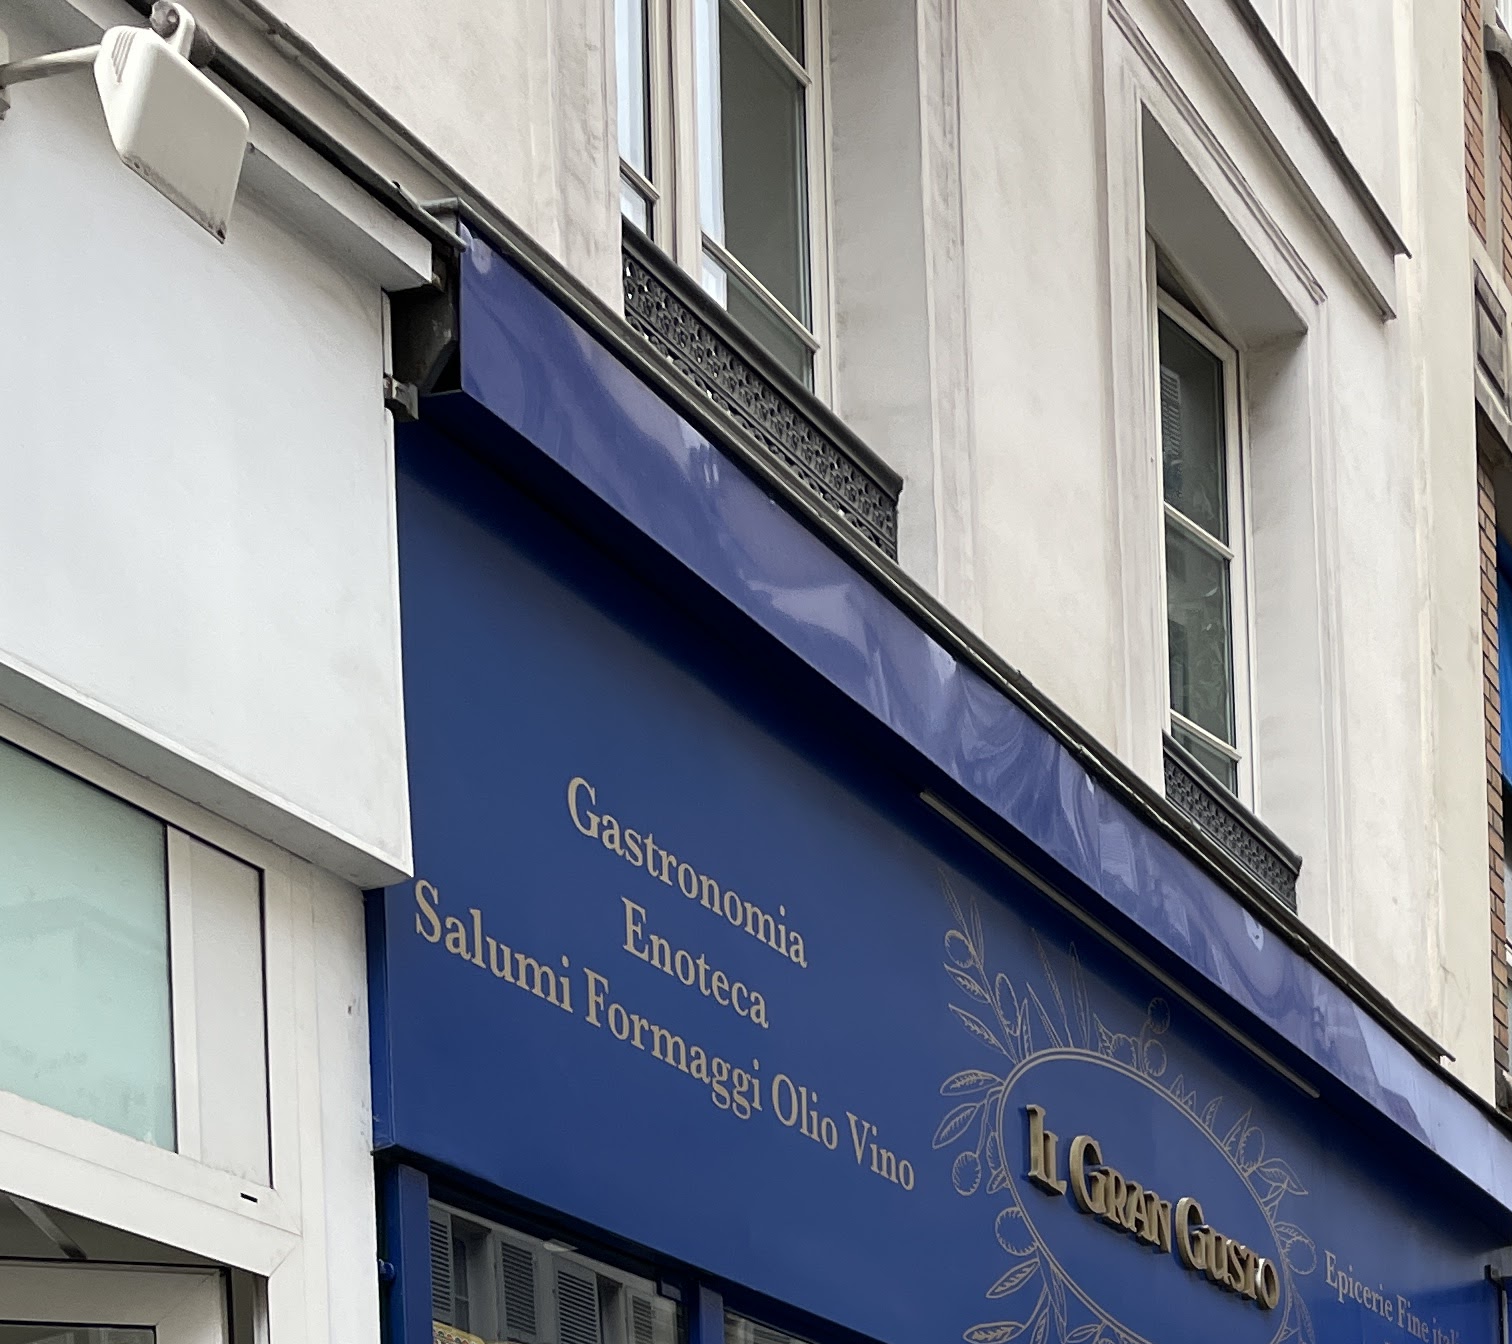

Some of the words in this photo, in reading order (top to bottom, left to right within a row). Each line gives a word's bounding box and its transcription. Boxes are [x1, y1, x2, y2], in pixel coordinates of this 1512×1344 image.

[567, 775, 808, 969] Gastronomia
[414, 878, 574, 1014] Salumi
[583, 966, 763, 1120] Formaggi
[771, 1073, 838, 1151] Olio
[846, 1110, 915, 1191] Vino
[620, 896, 770, 1029] Enoteca
[1324, 1249, 1394, 1323] Epicerie
[1396, 1294, 1430, 1344] Fine
